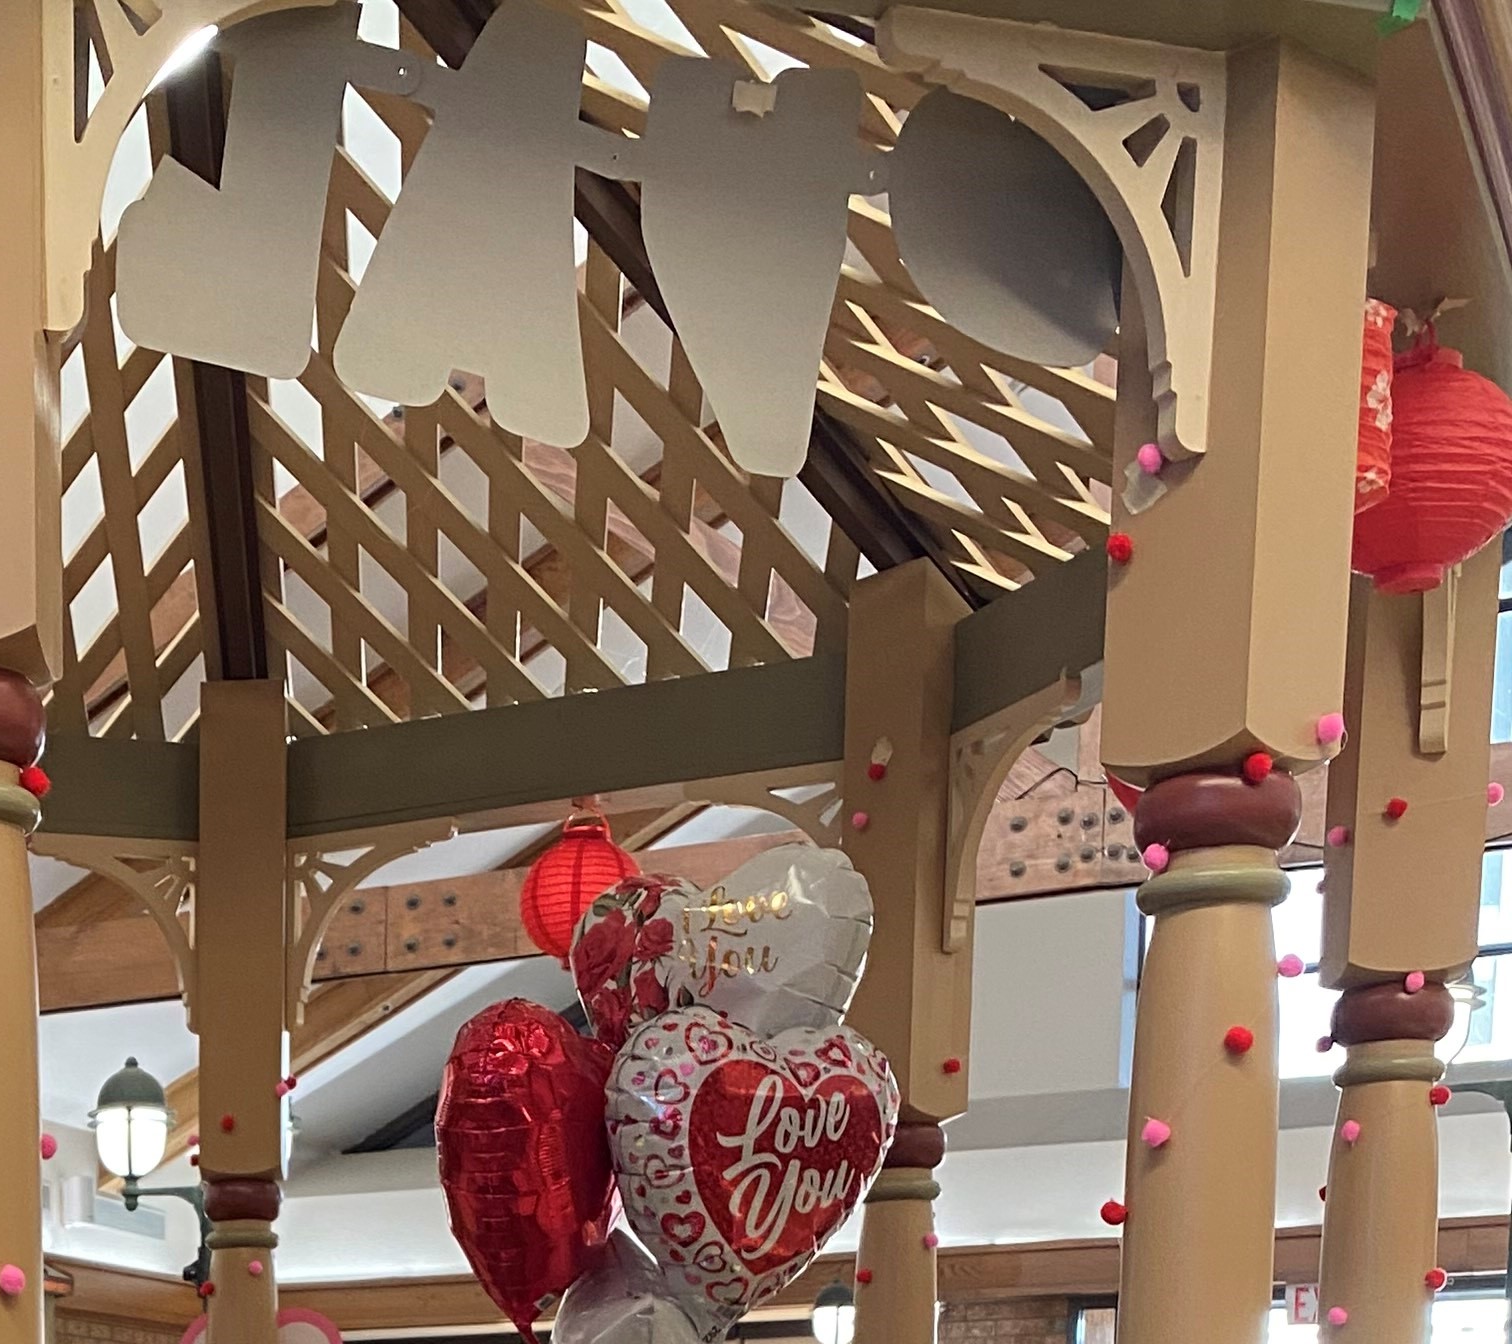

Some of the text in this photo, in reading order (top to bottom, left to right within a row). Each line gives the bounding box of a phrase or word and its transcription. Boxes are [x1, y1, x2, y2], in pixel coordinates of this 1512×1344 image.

[700, 886, 793, 937] Love
[677, 935, 779, 998] You
[716, 1074, 850, 1181] Love
[728, 1158, 855, 1260] You
